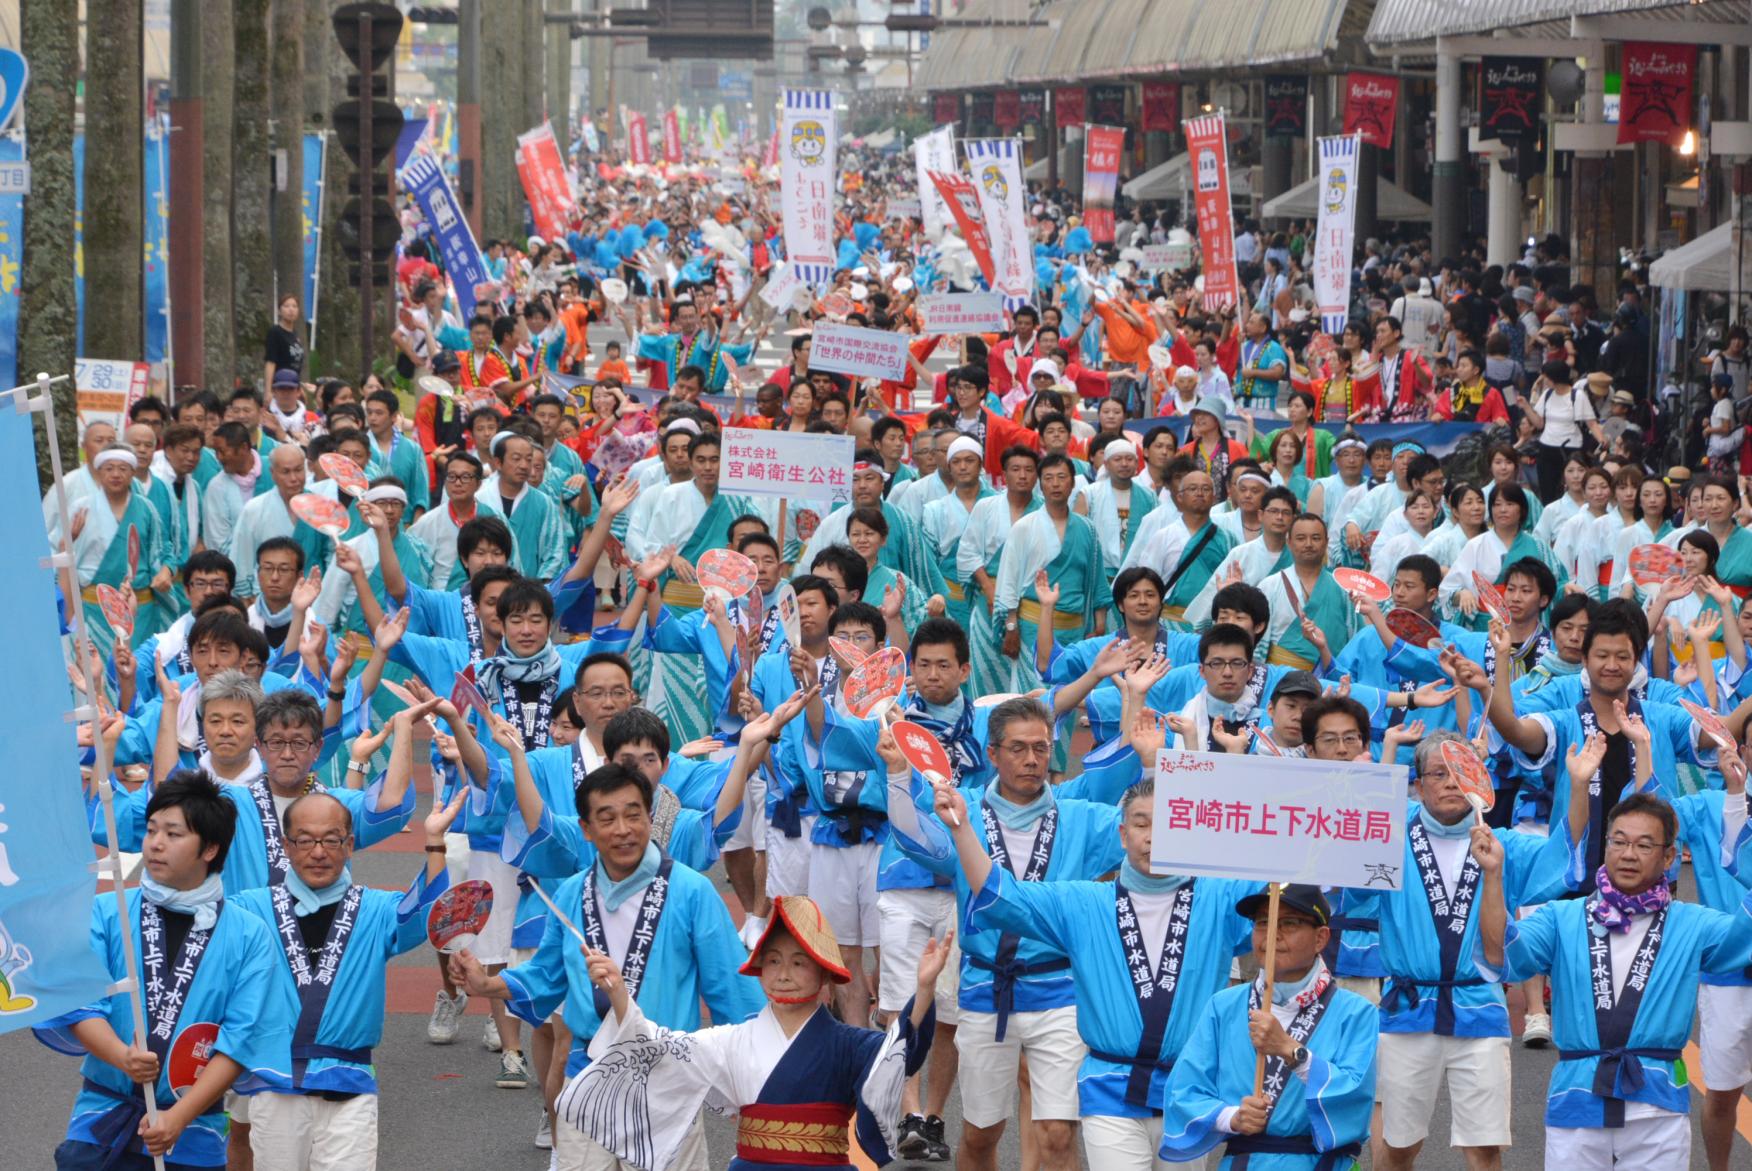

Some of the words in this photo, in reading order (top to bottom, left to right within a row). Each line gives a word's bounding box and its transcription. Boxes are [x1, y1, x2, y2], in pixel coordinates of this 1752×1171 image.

[815, 344, 902, 369] 「世界の仲間たち」
[817, 334, 899, 353] 宮崎市国際交流協会
[728, 445, 777, 460] 株式会社
[728, 461, 846, 485] 宮崎衛生公社
[1168, 797, 1391, 844] 宮崎市上下水道局
[1410, 824, 1450, 917] 宮崎市水道局
[1115, 896, 1155, 1000] 宮崎市水道局
[1157, 889, 1195, 992] 宮崎市水道局
